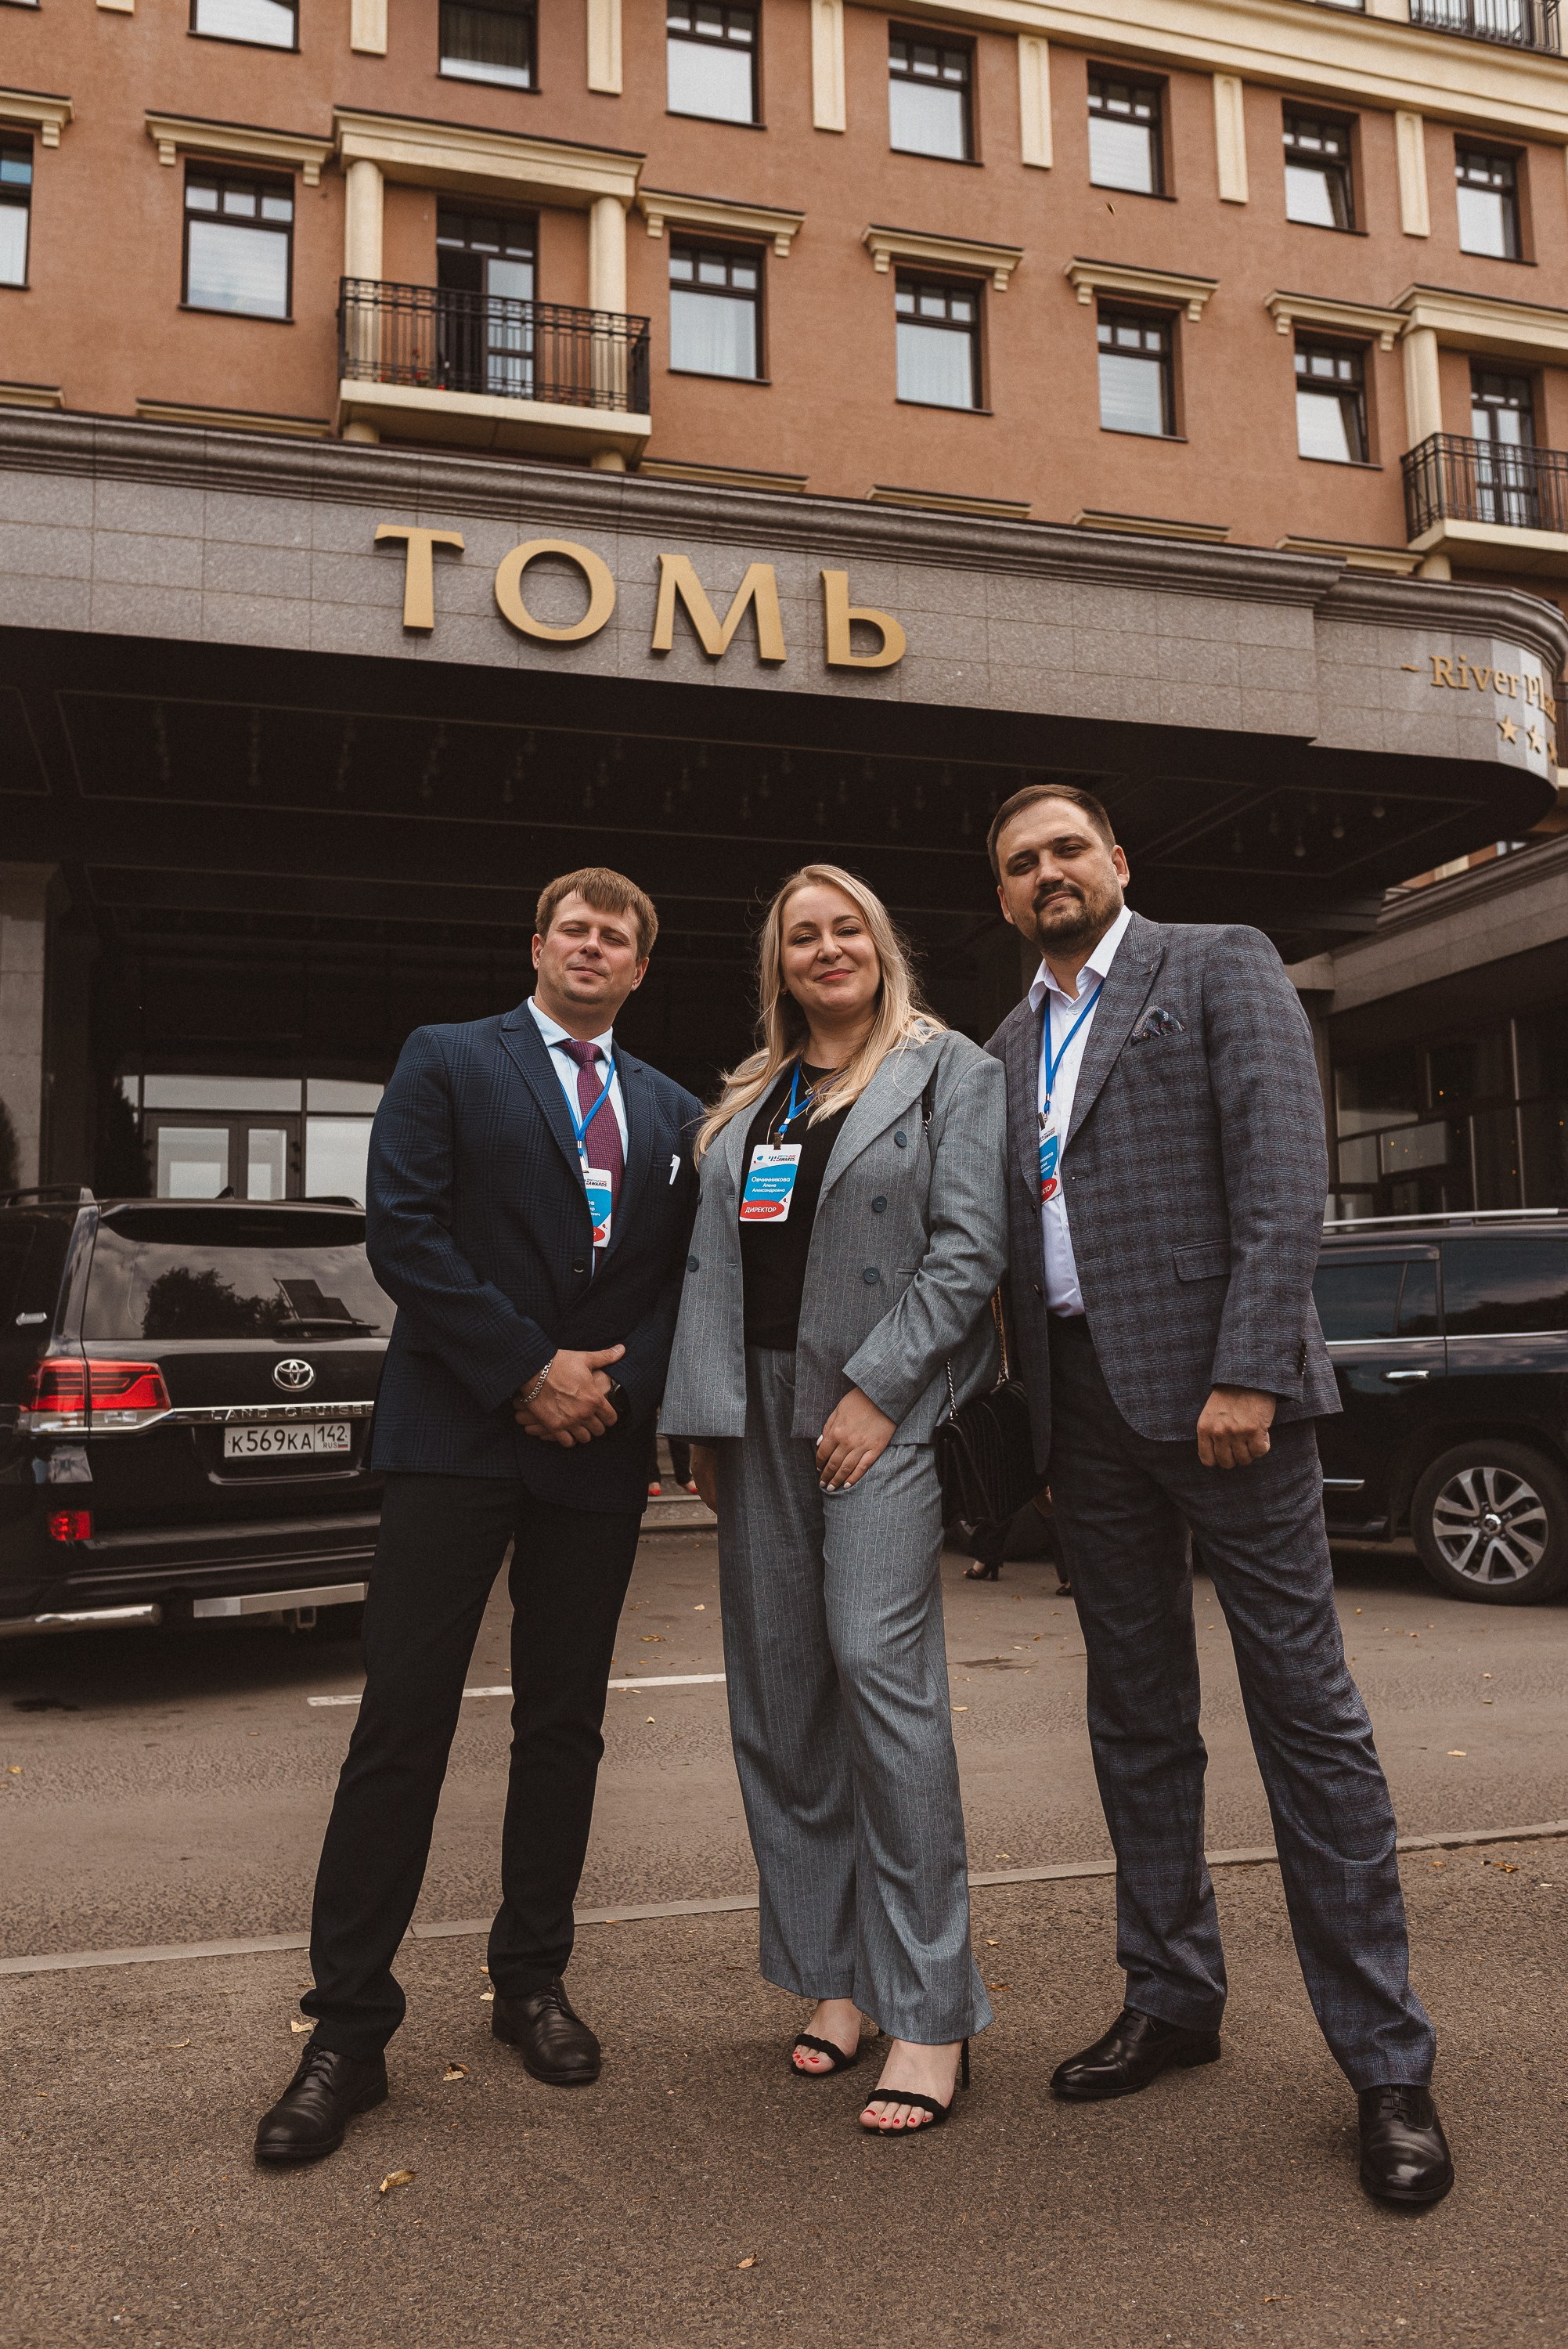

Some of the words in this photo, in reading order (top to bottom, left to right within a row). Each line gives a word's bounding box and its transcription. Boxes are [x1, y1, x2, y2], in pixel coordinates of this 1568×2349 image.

[374, 523, 907, 669] ТОМЬ
[1429, 655, 1520, 698] River
[211, 1409, 269, 1421] LAND
[317, 1425, 345, 1442] 142
